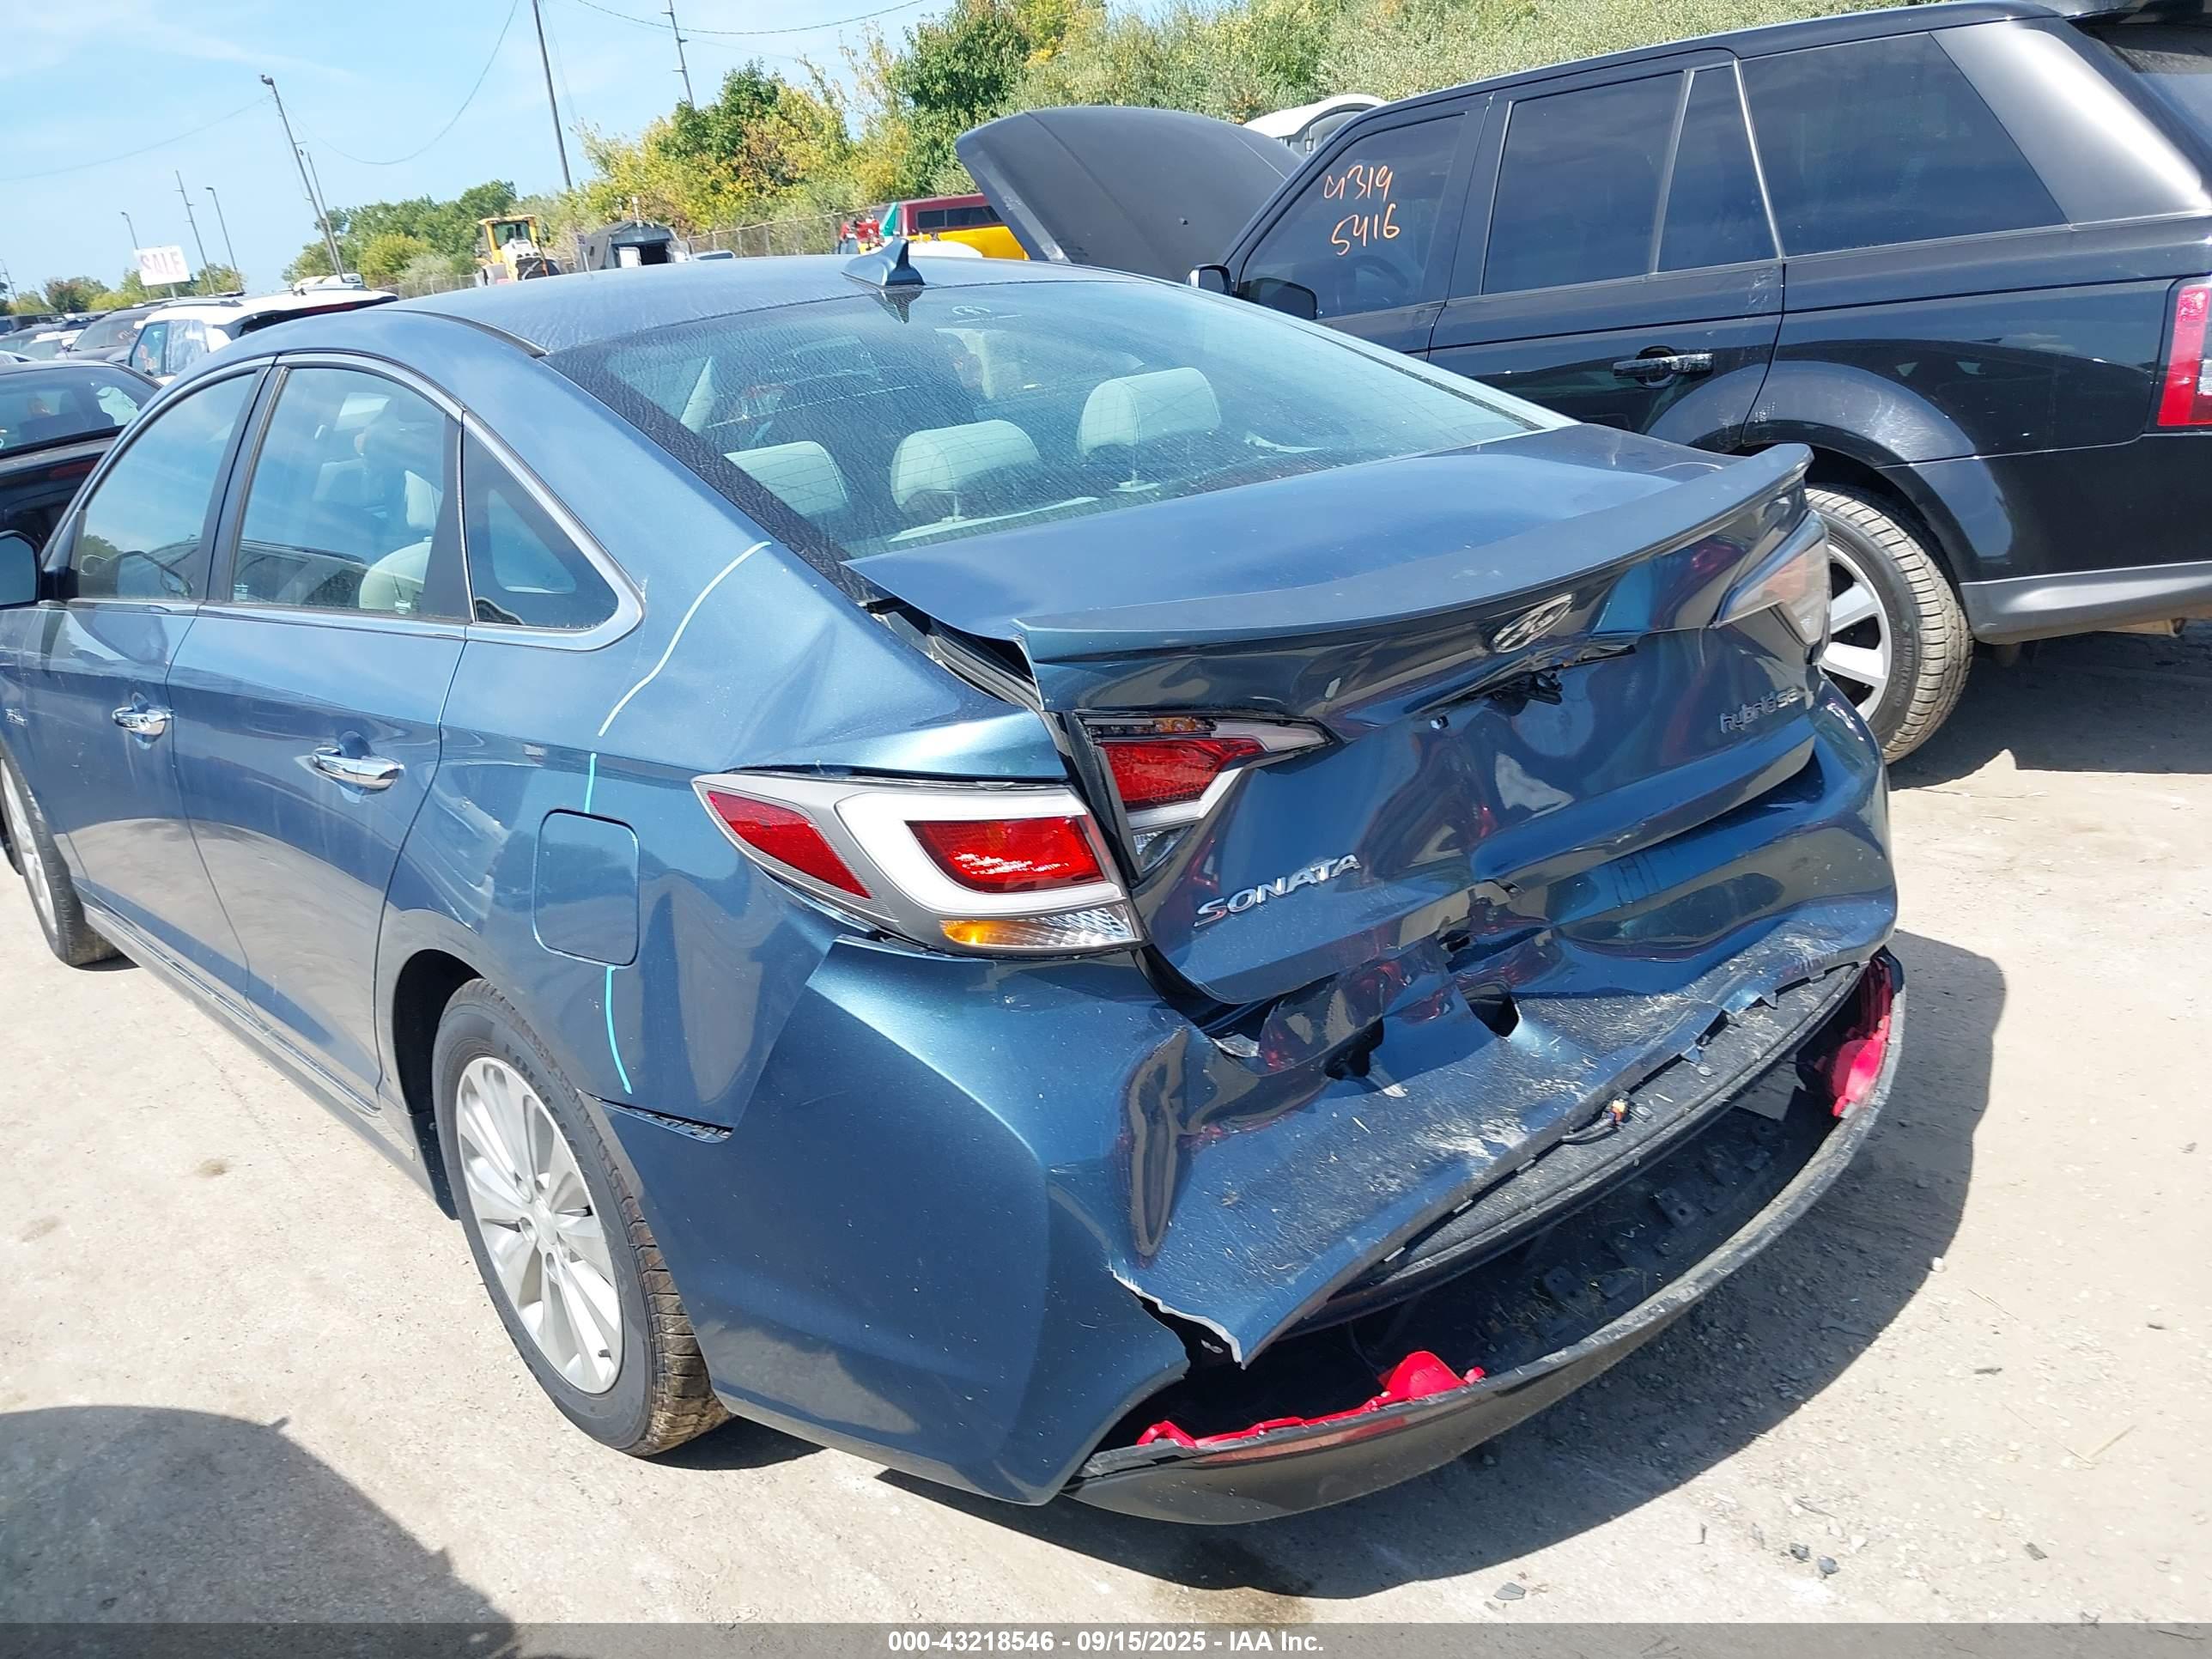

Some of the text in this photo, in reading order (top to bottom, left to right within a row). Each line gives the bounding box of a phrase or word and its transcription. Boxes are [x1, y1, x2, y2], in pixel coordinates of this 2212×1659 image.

[1331, 203, 1401, 256] 5416
[140, 251, 180, 275] SALE
[1193, 854, 1361, 927] SONATA
